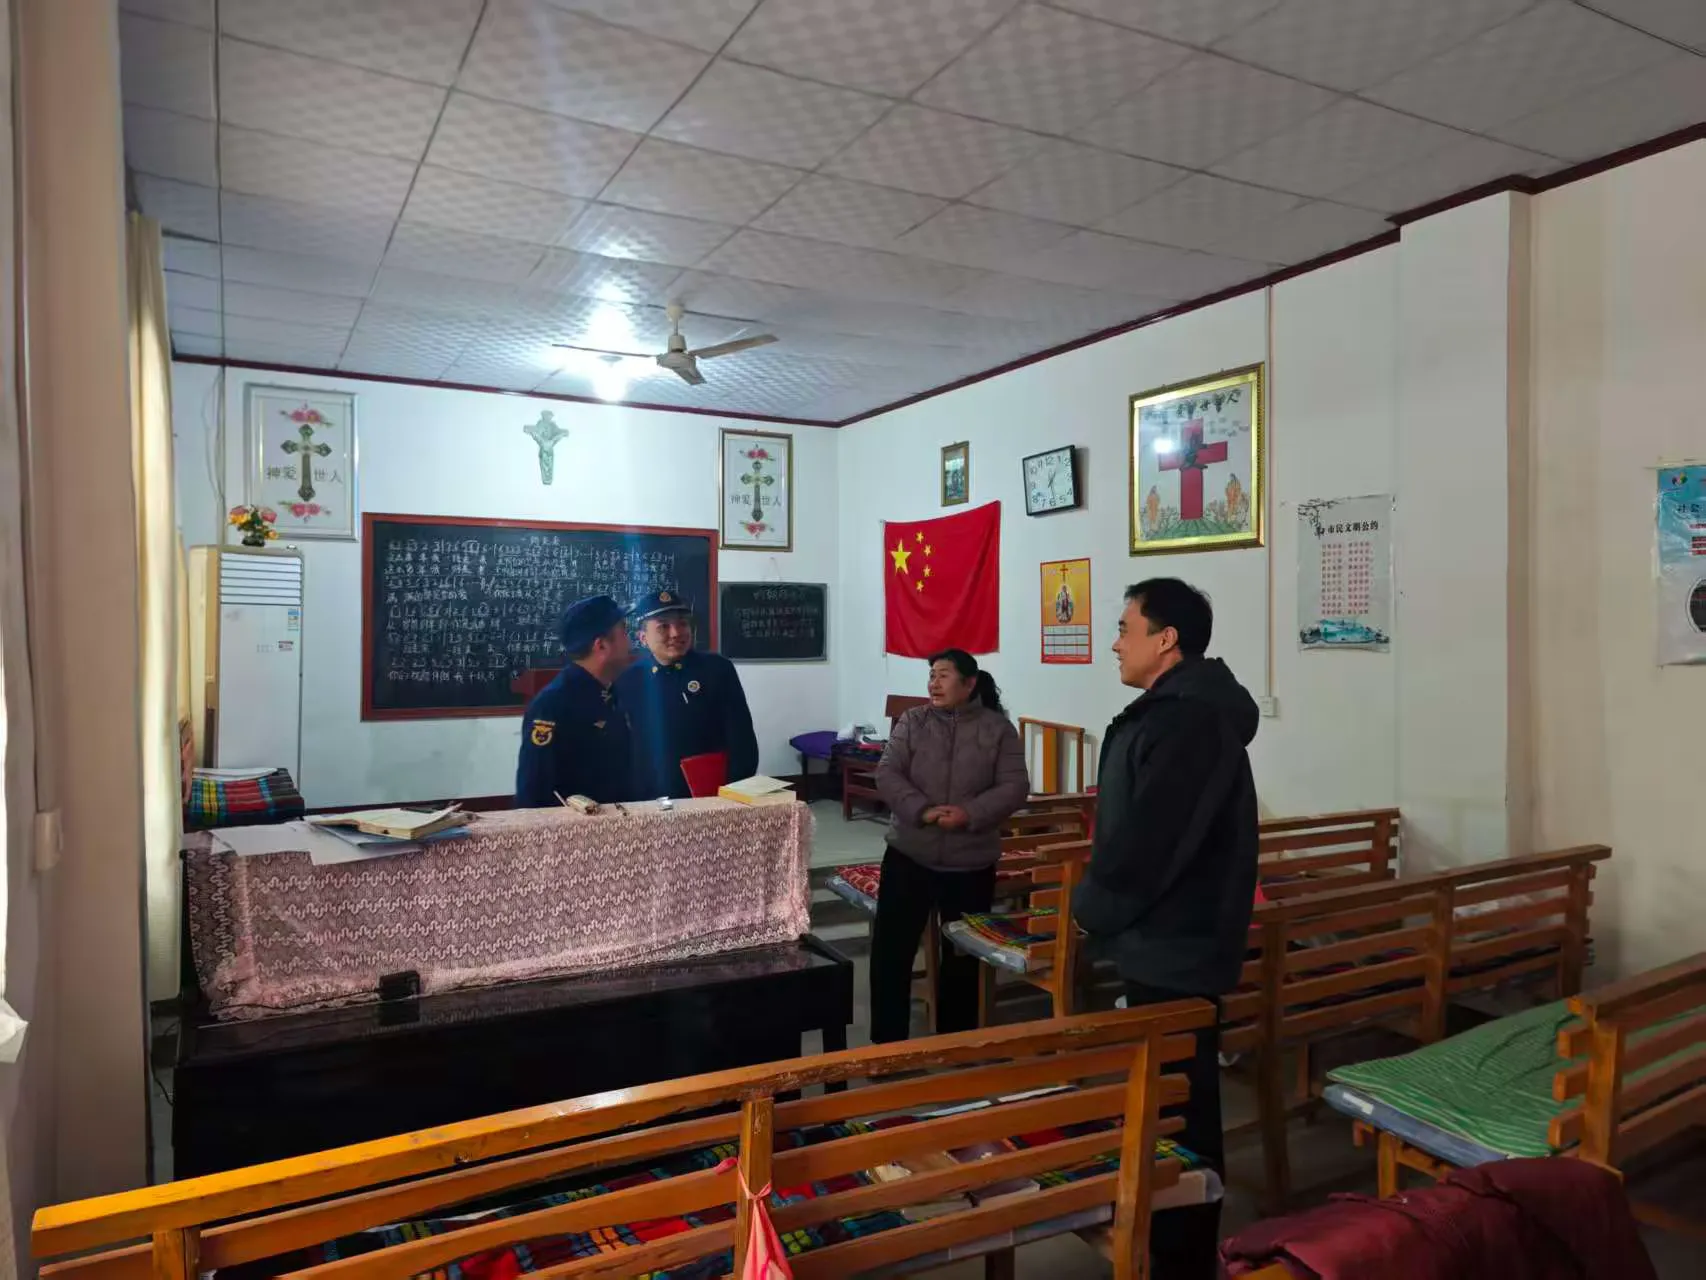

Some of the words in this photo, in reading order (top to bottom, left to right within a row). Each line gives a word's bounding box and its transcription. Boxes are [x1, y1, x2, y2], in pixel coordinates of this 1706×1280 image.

[314, 467, 343, 483] 世人
[1327, 519, 1379, 535] 市民文明公约
